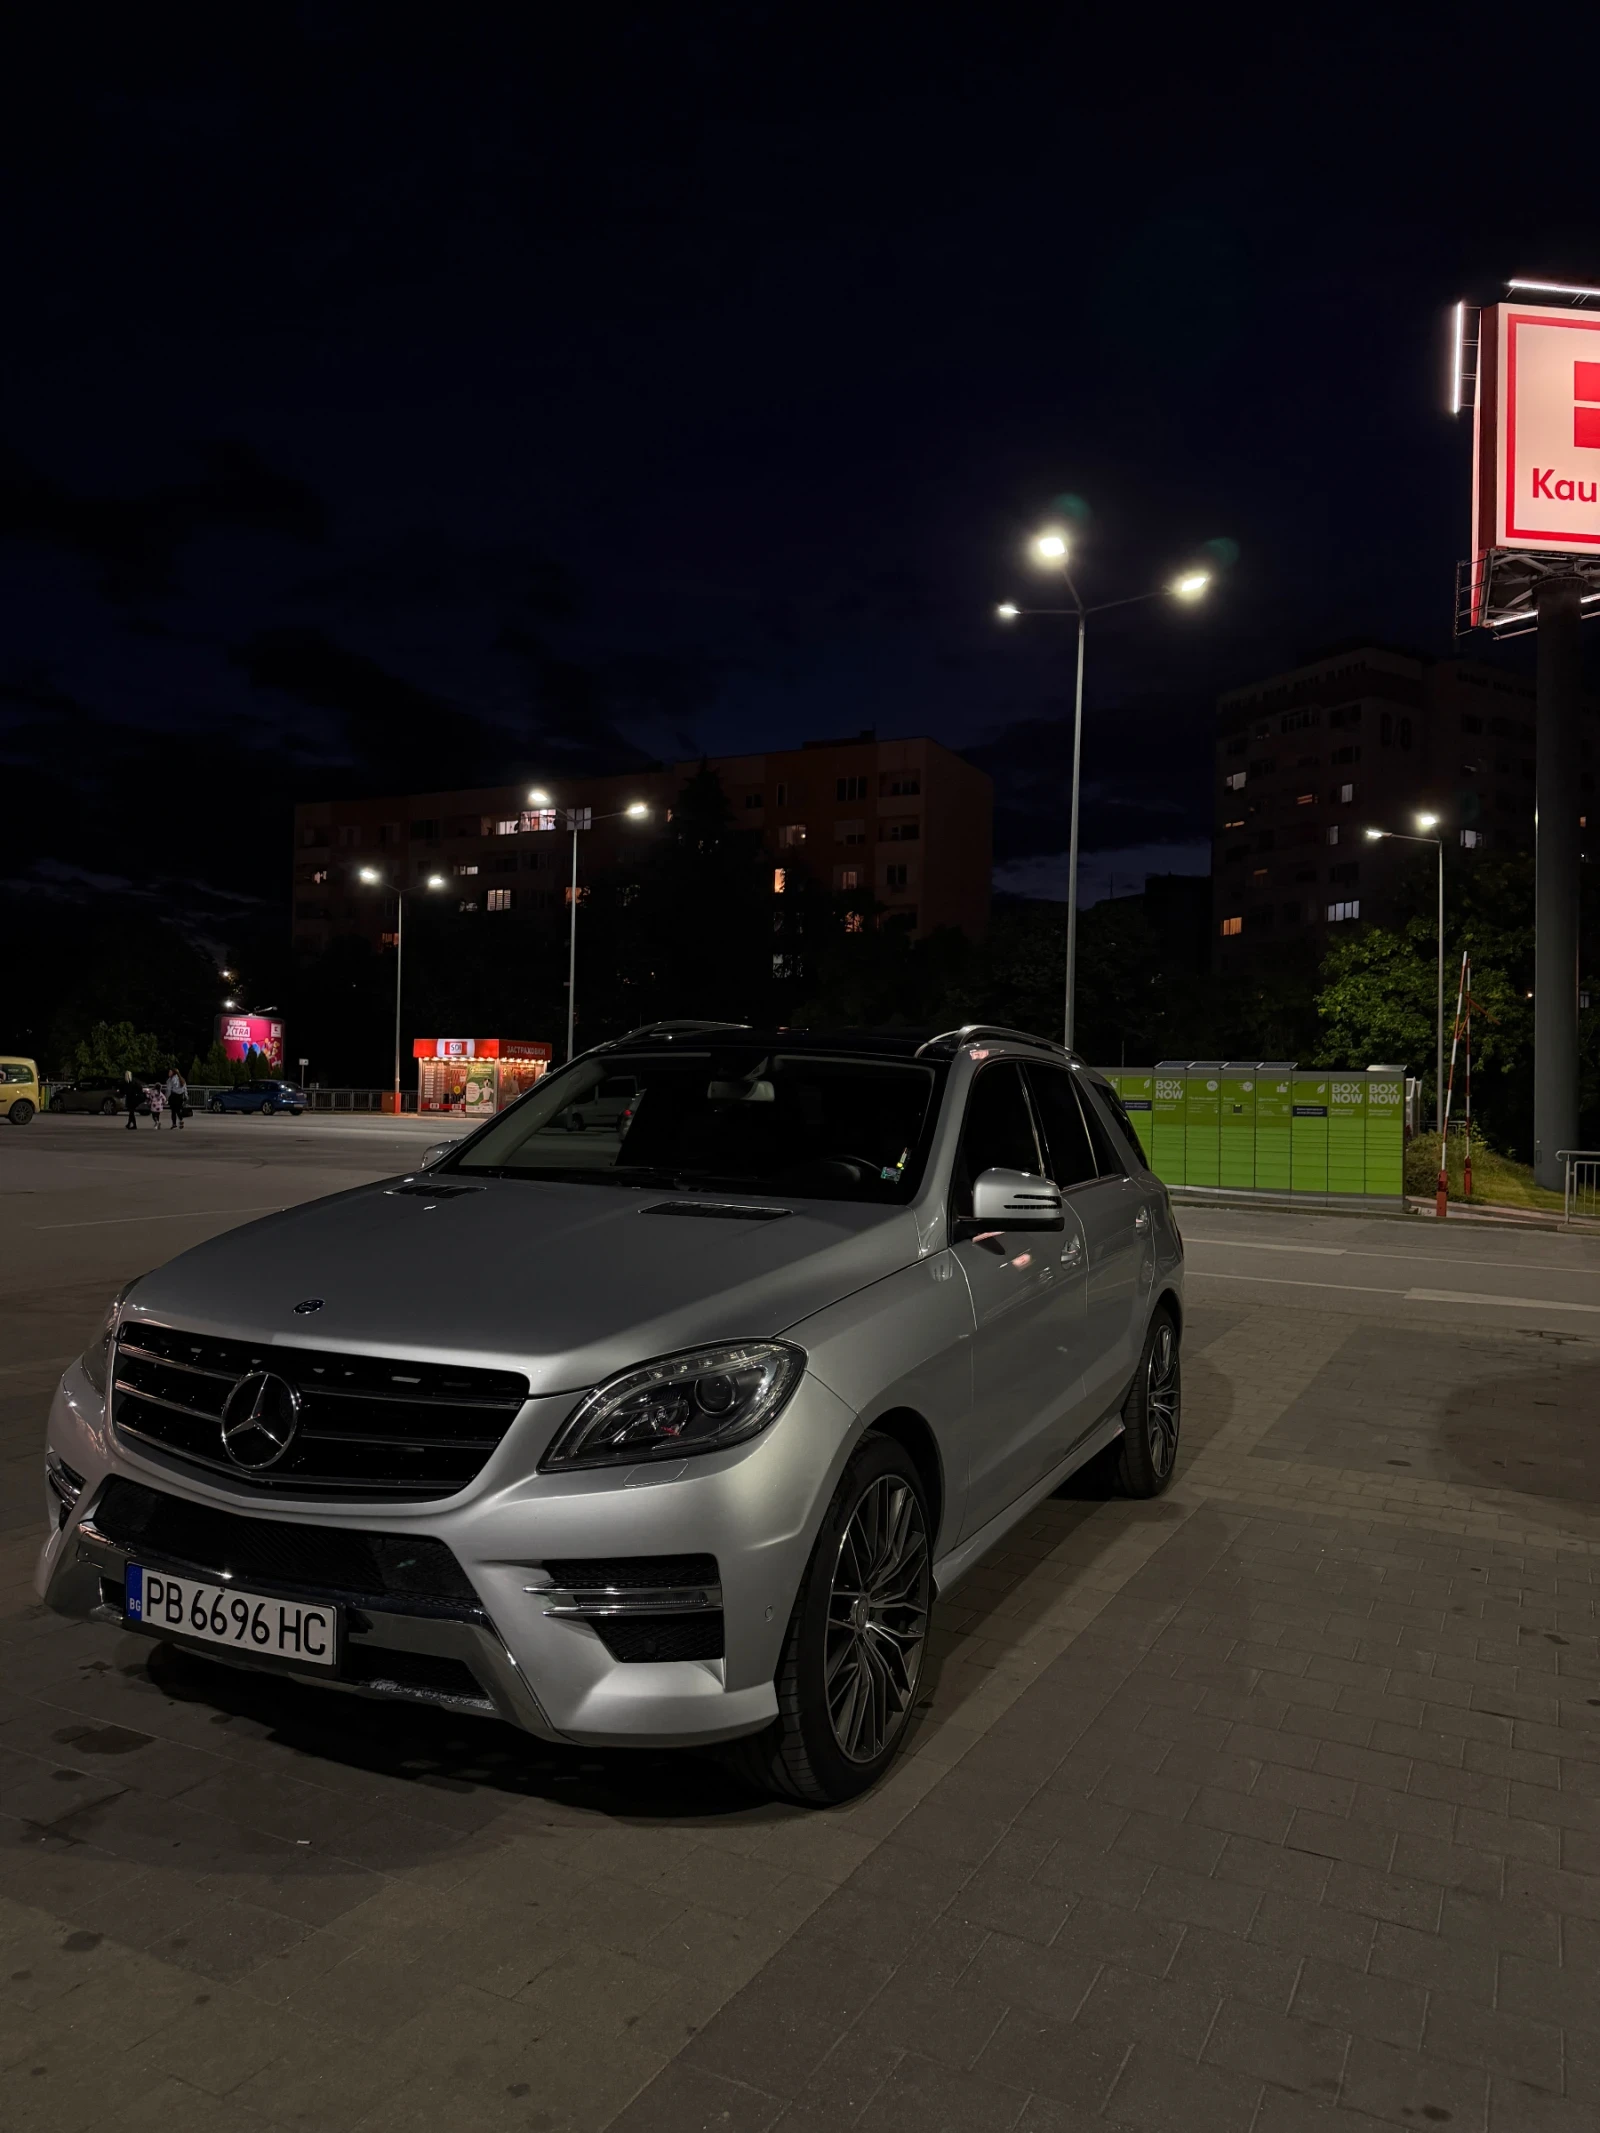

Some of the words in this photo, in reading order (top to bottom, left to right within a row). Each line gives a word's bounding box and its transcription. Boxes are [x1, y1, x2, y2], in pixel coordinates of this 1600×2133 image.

[1532, 467, 1597, 503] Kau
[225, 1025, 249, 1036] XTRA
[506, 1045, 546, 1056] ЗАСТРАХОВКИ
[1155, 1080, 1181, 1090] BOX
[1332, 1083, 1360, 1093] BOX
[1369, 1084, 1398, 1094] BOX
[1155, 1090, 1183, 1100] NOW
[1331, 1093, 1363, 1104] NOW
[1369, 1094, 1400, 1105] NOW
[129, 1597, 141, 1612] BG
[146, 1576, 183, 1624] PB
[190, 1589, 270, 1645] 6696
[279, 1606, 326, 1656] HC
